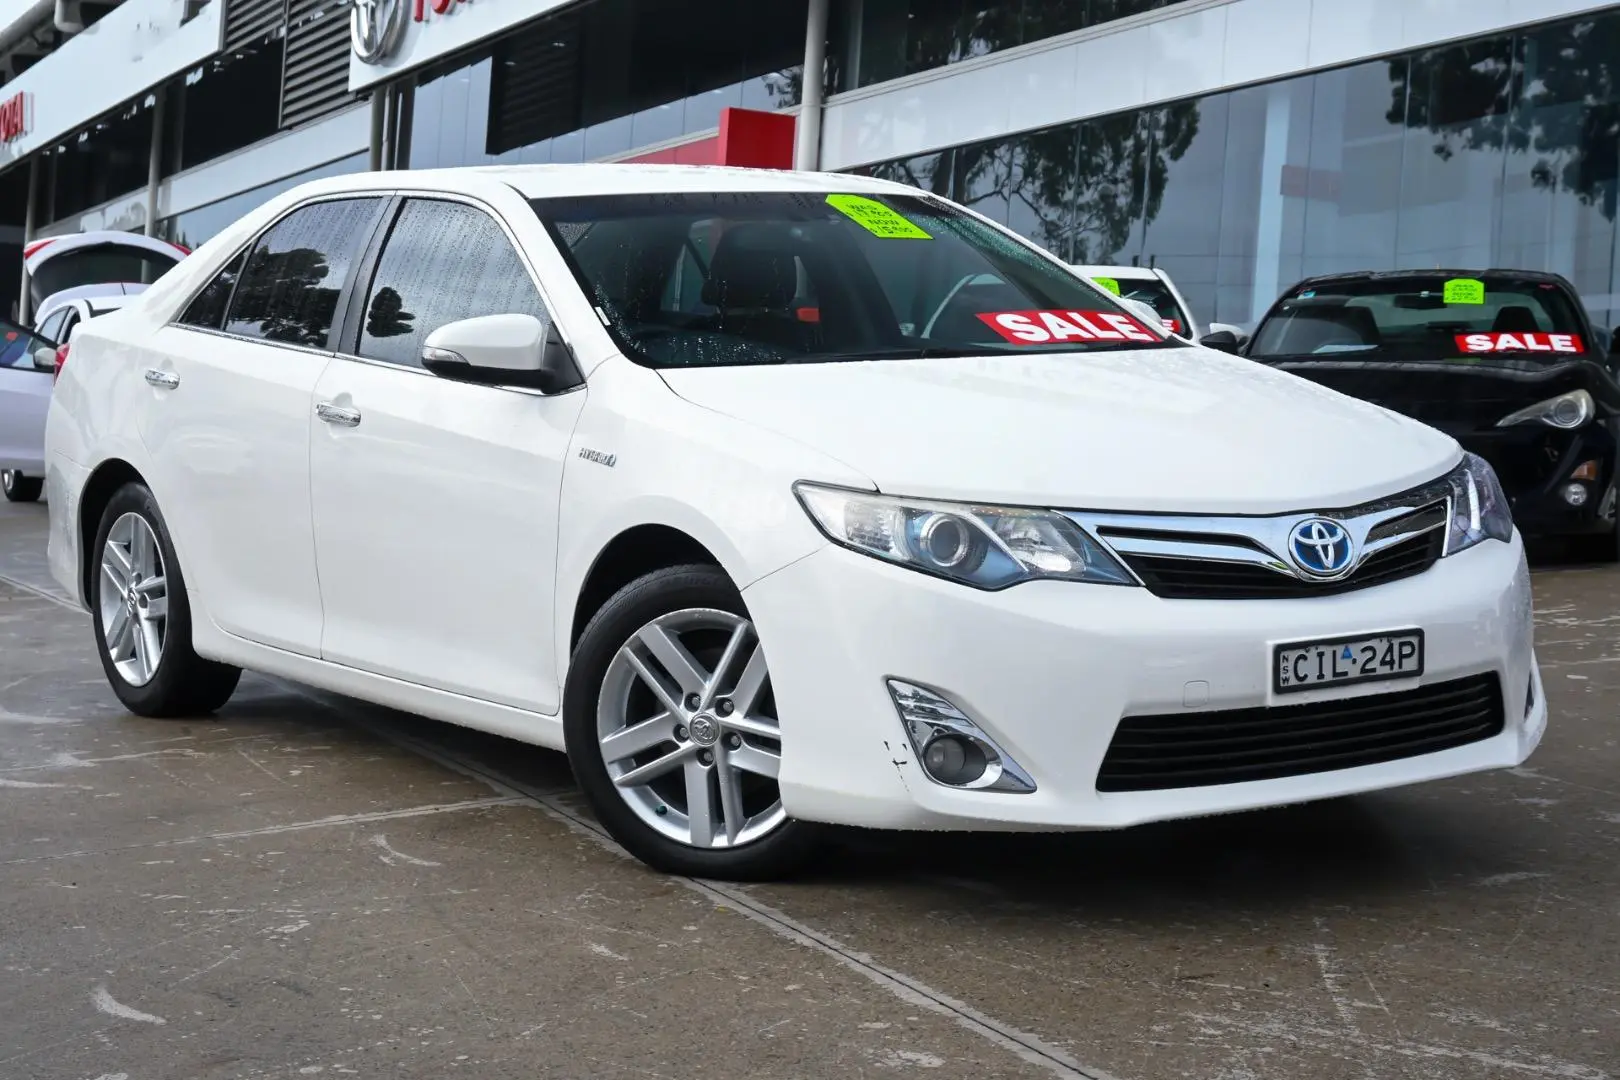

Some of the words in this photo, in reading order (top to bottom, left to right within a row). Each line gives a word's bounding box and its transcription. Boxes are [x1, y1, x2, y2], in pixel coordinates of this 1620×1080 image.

[996, 312, 1154, 342] SALE
[1465, 333, 1577, 352] SALE
[1281, 654, 1291, 685] NSW
